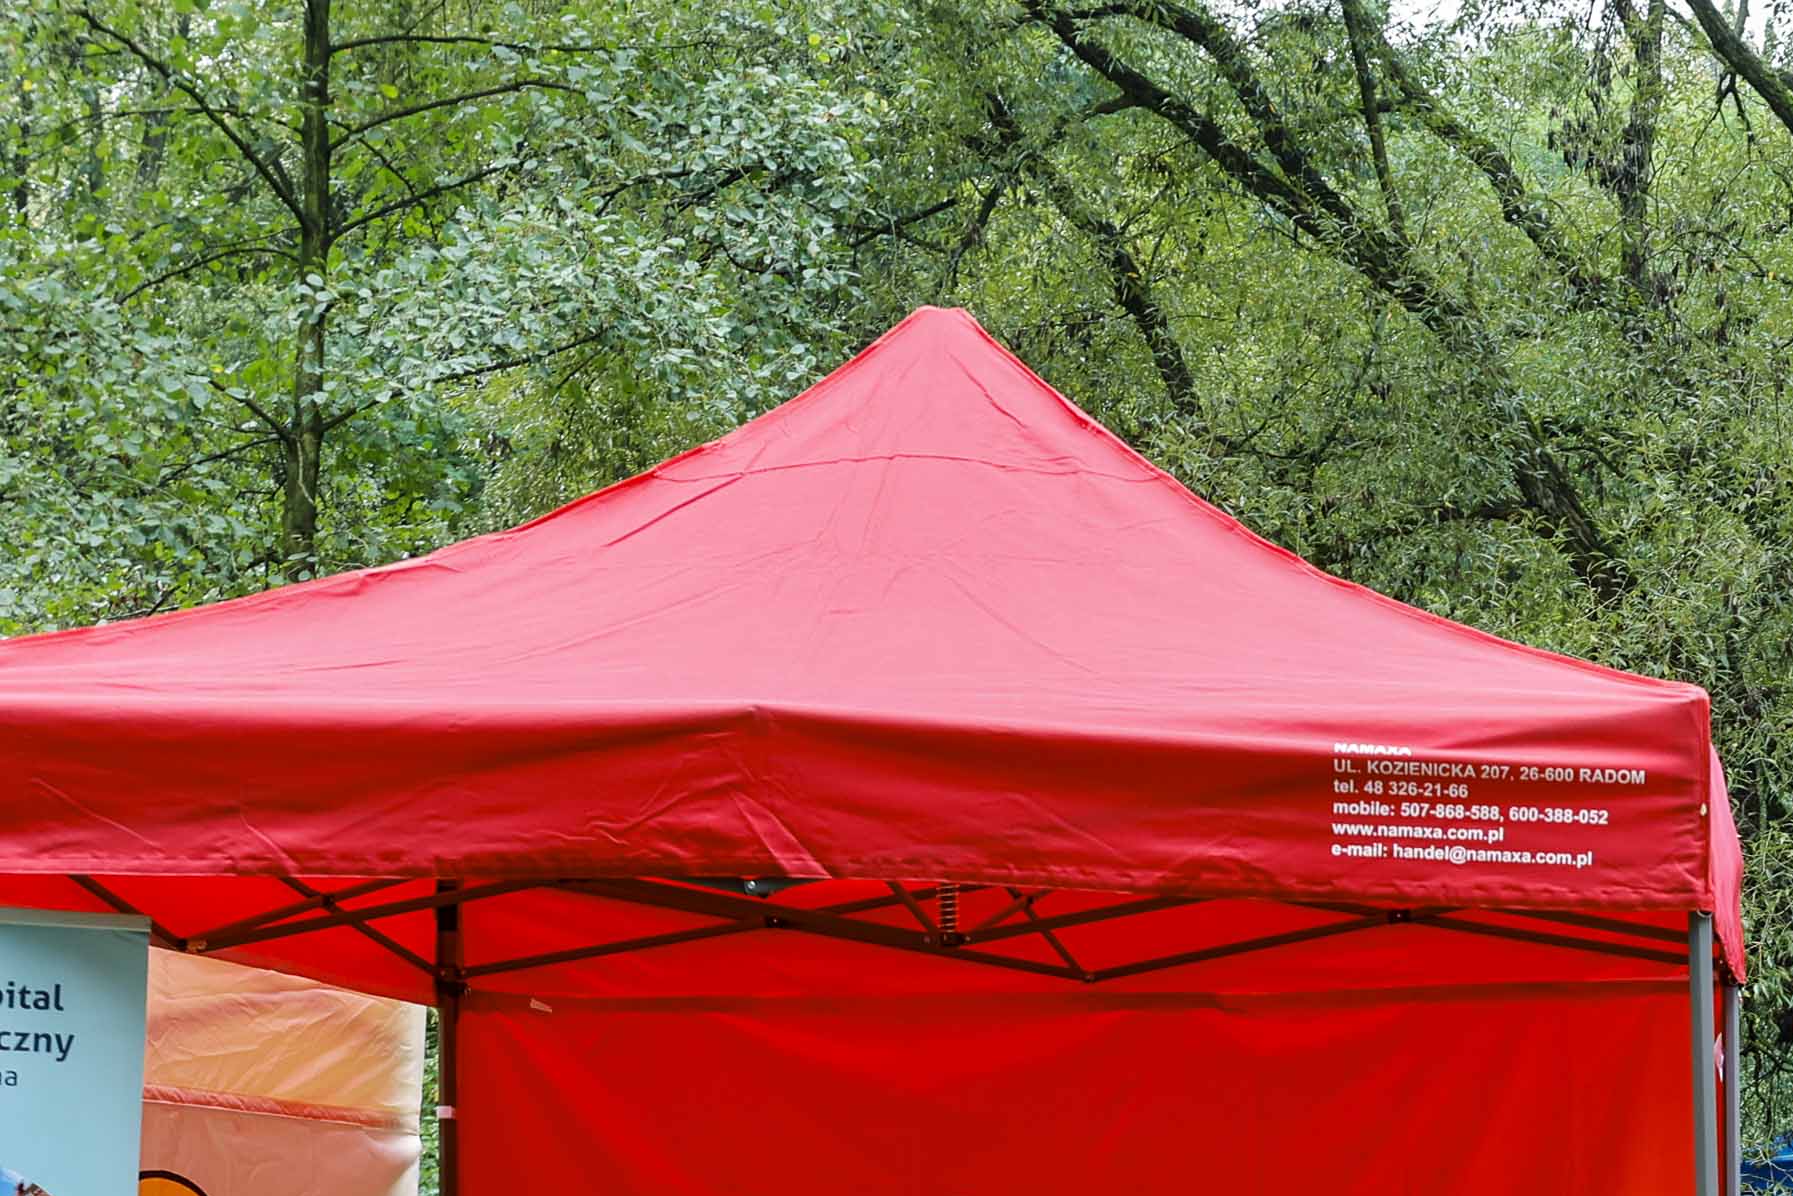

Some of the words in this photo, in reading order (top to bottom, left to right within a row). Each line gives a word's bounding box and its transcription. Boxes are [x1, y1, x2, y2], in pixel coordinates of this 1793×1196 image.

[1333, 758, 1361, 773] UL.
[1367, 760, 1476, 778] KOZIENICKA
[1481, 765, 1515, 781] 207,
[1519, 766, 1574, 782] 26-600
[1579, 768, 1646, 785] RADOM
[1333, 779, 1359, 793] tel.
[1363, 780, 1384, 795] 48
[1388, 781, 1469, 798] 326-21-66
[1331, 800, 1395, 816] mobile:
[1400, 802, 1504, 822] 507-868-588,
[1509, 806, 1609, 825] 600-388-052
[1331, 822, 1504, 844] www.namaxa.com.pl
[1331, 843, 1388, 858] e-mail:
[1393, 843, 1593, 867] handel@namaxa.com.pl
[0, 981, 64, 1012] ital
